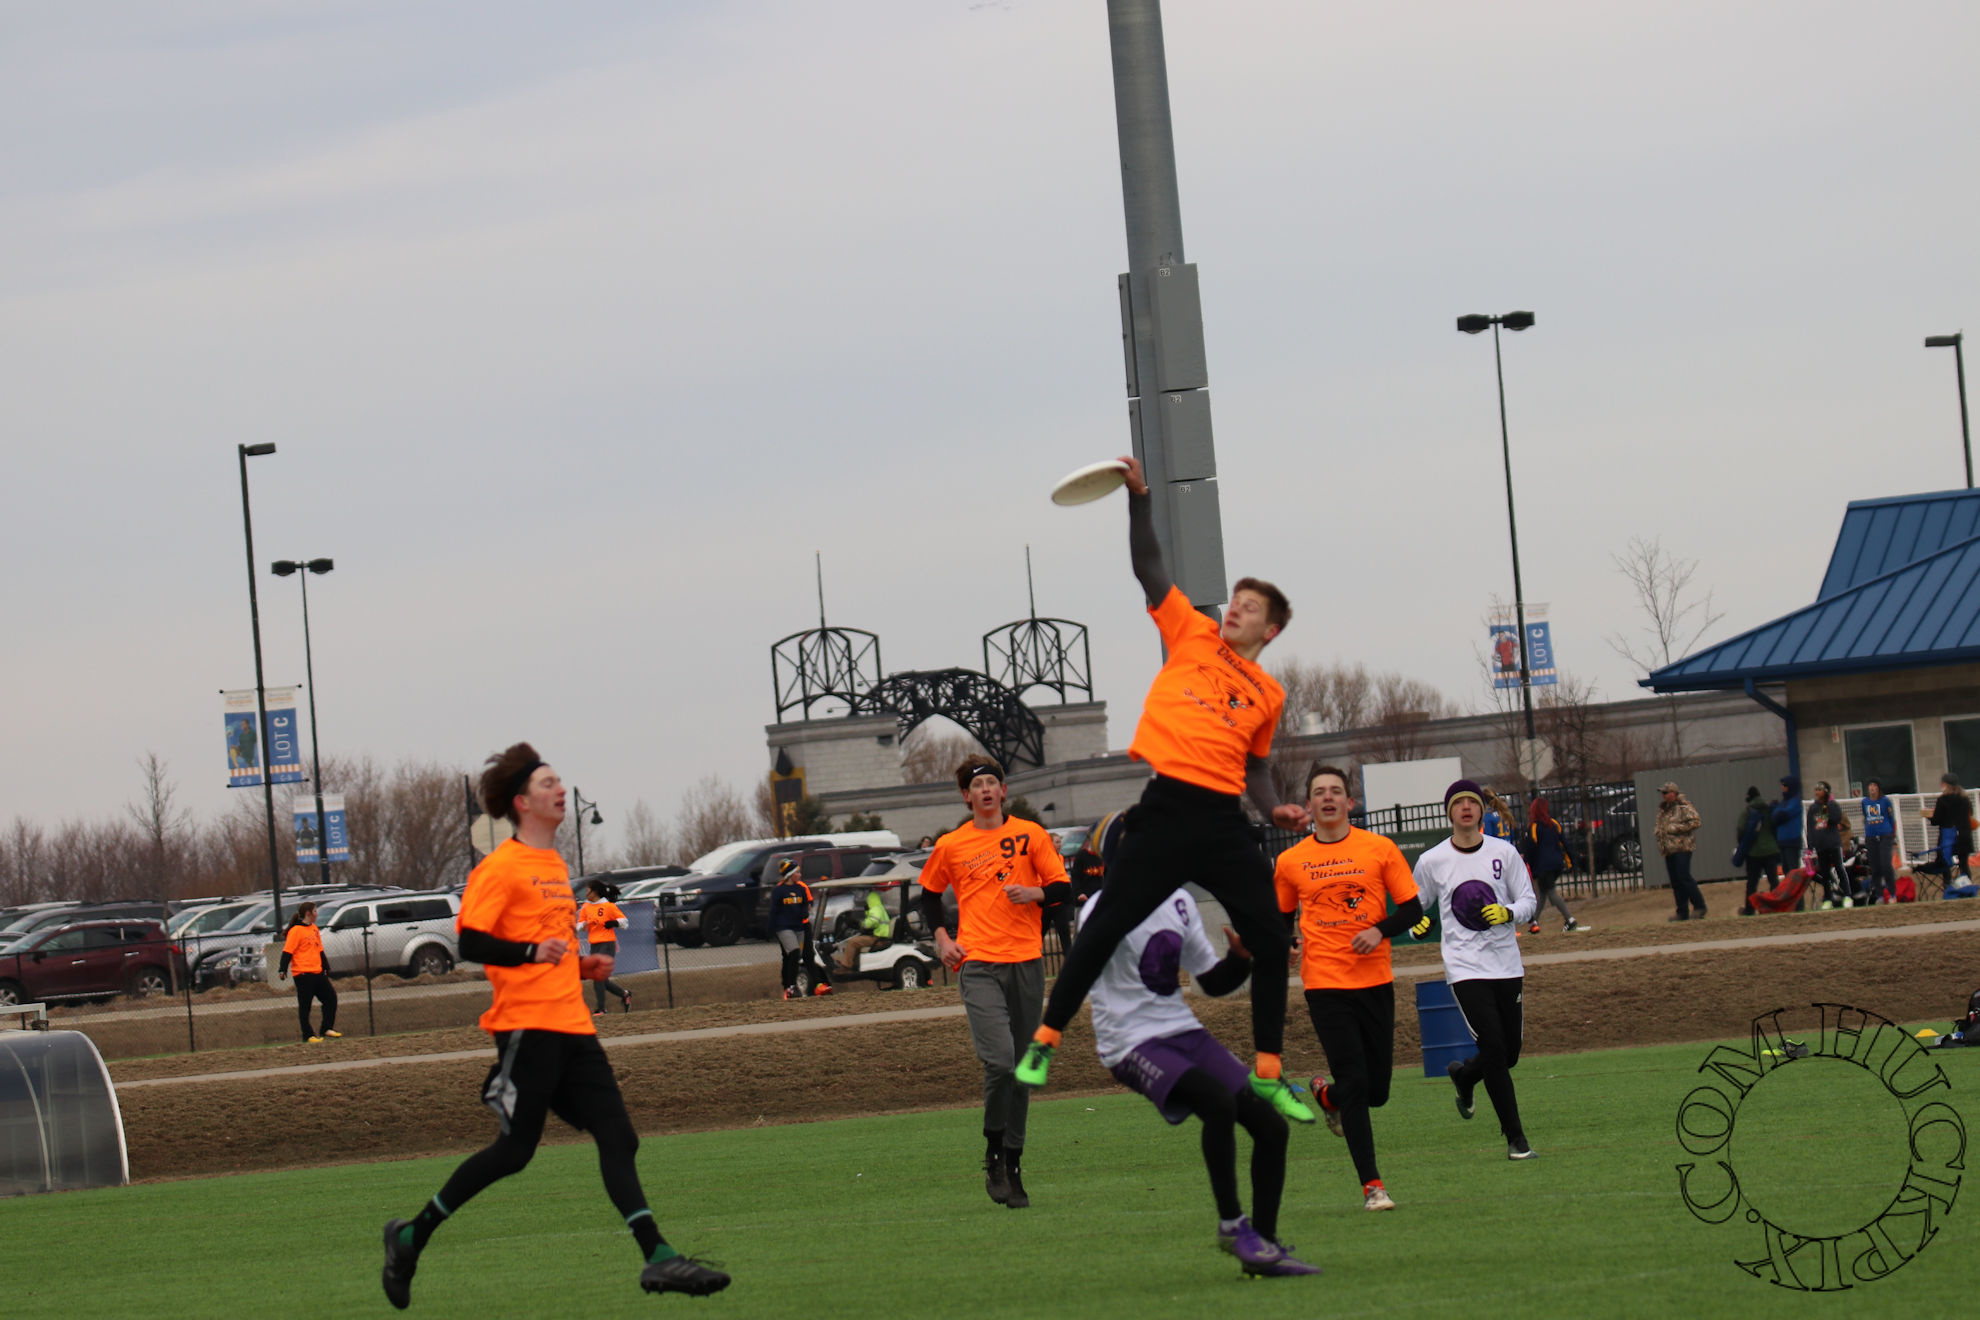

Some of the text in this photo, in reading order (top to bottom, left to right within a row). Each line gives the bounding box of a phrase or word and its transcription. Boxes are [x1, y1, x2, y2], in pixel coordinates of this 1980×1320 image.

[1532, 628, 1544, 639] C
[1533, 641, 1548, 665] LOT
[273, 716, 289, 728] C
[274, 732, 292, 760] LOT
[330, 815, 340, 824] C
[330, 827, 342, 845] LOT
[1000, 833, 1030, 859] 97
[1492, 858, 1503, 880] 9
[597, 907, 604, 917] 6
[1174, 898, 1190, 927] 6
